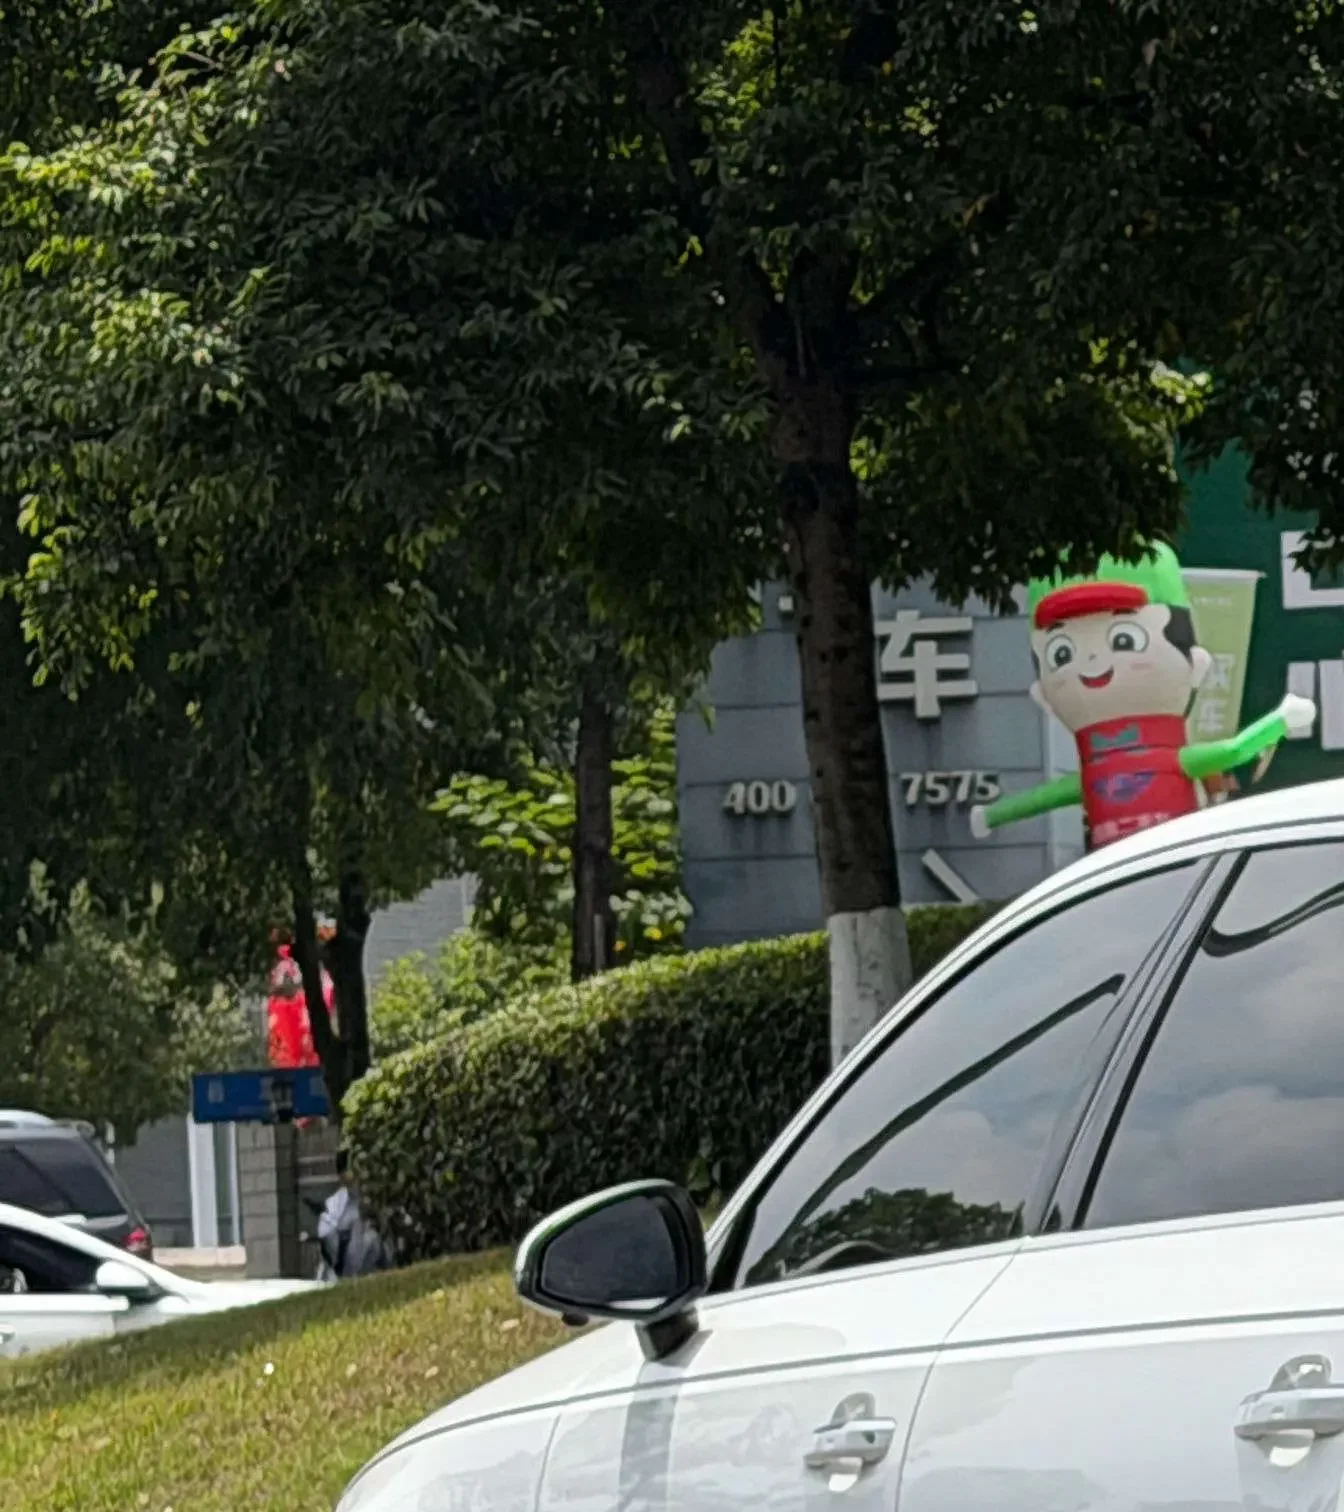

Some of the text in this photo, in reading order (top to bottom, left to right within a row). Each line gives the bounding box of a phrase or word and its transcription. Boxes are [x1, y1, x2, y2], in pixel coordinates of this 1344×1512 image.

[873, 609, 980, 719] 车
[721, 769, 1002, 815] 400 7575
